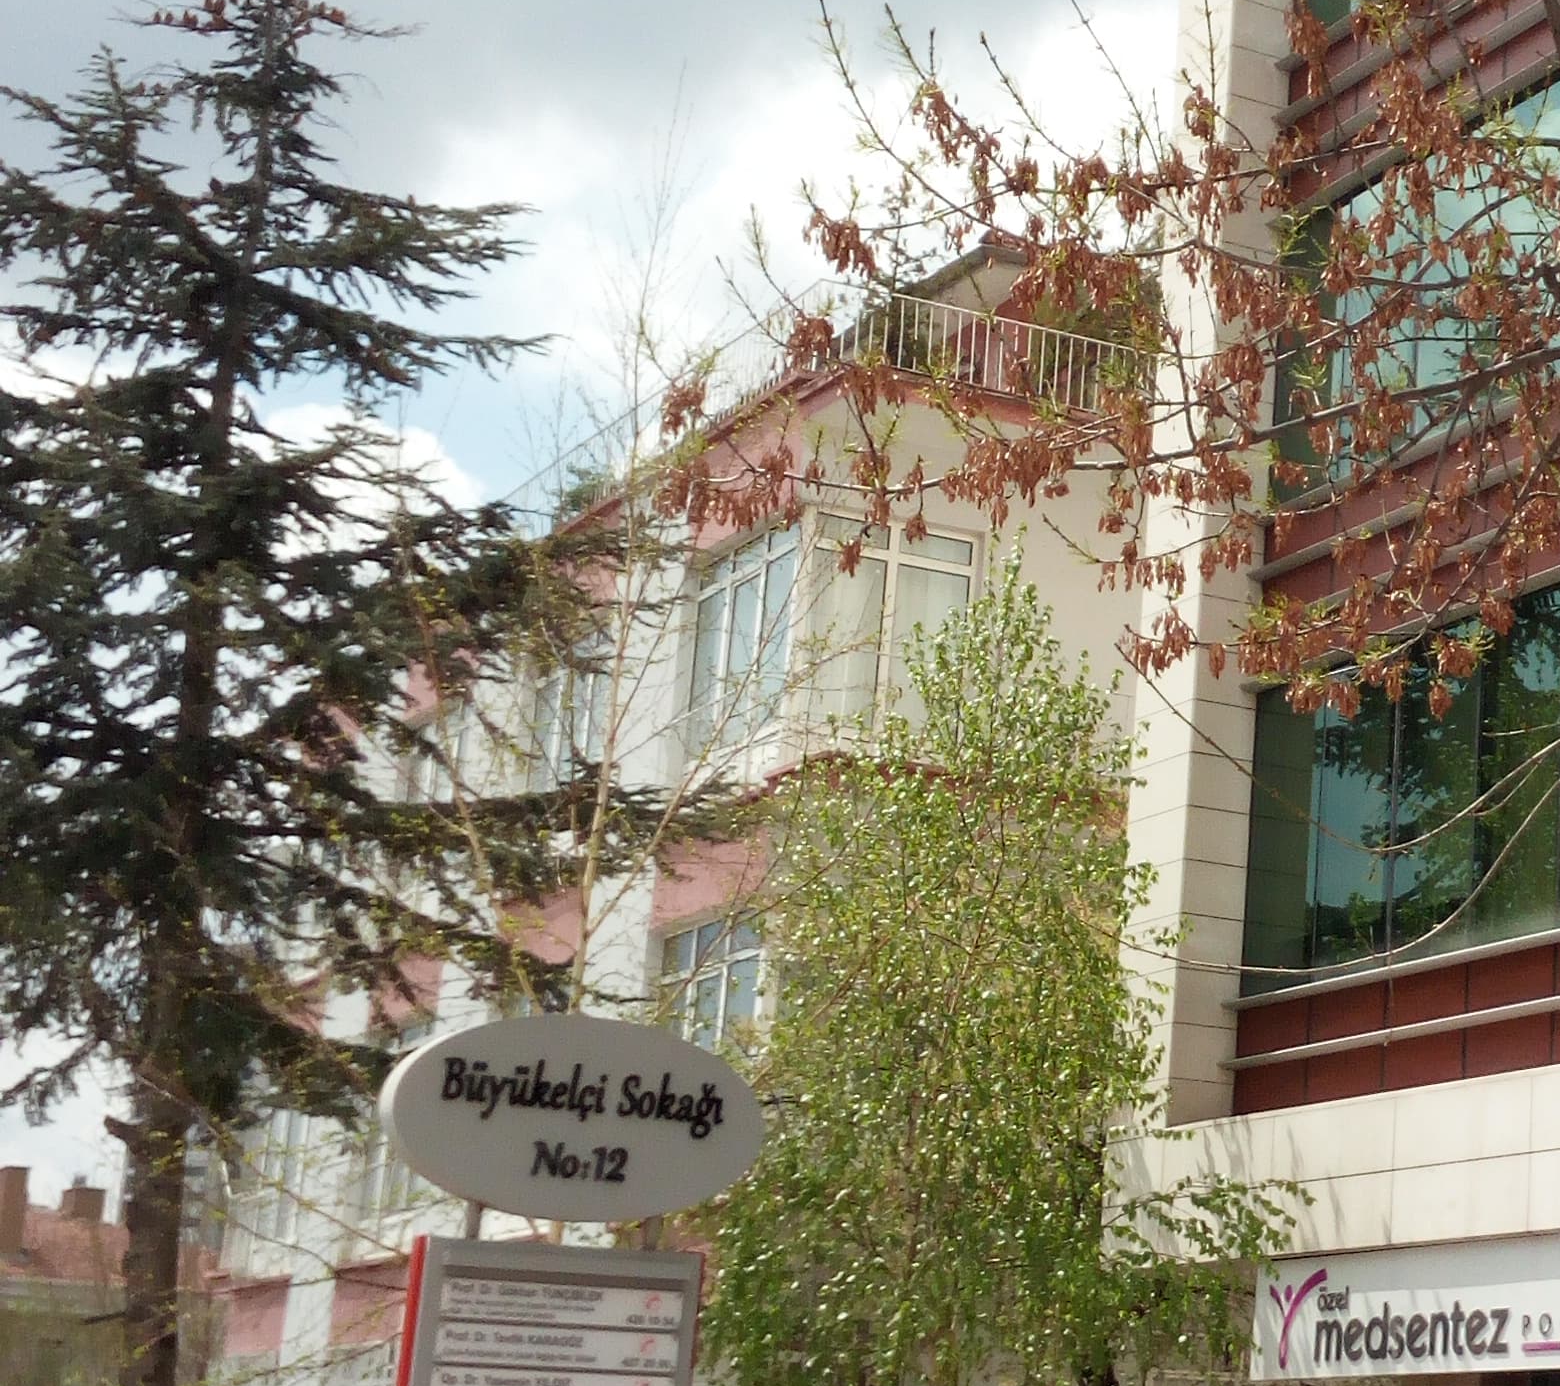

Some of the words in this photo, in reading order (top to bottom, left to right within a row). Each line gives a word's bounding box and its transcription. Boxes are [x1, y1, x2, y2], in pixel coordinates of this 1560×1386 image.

[442, 1056, 609, 1121] Büyükelçi
[616, 1075, 724, 1140] Sokağı
[530, 1140, 629, 1184] No:12
[1317, 1285, 1350, 1312] özel
[1313, 1300, 1513, 1364] medsentez
